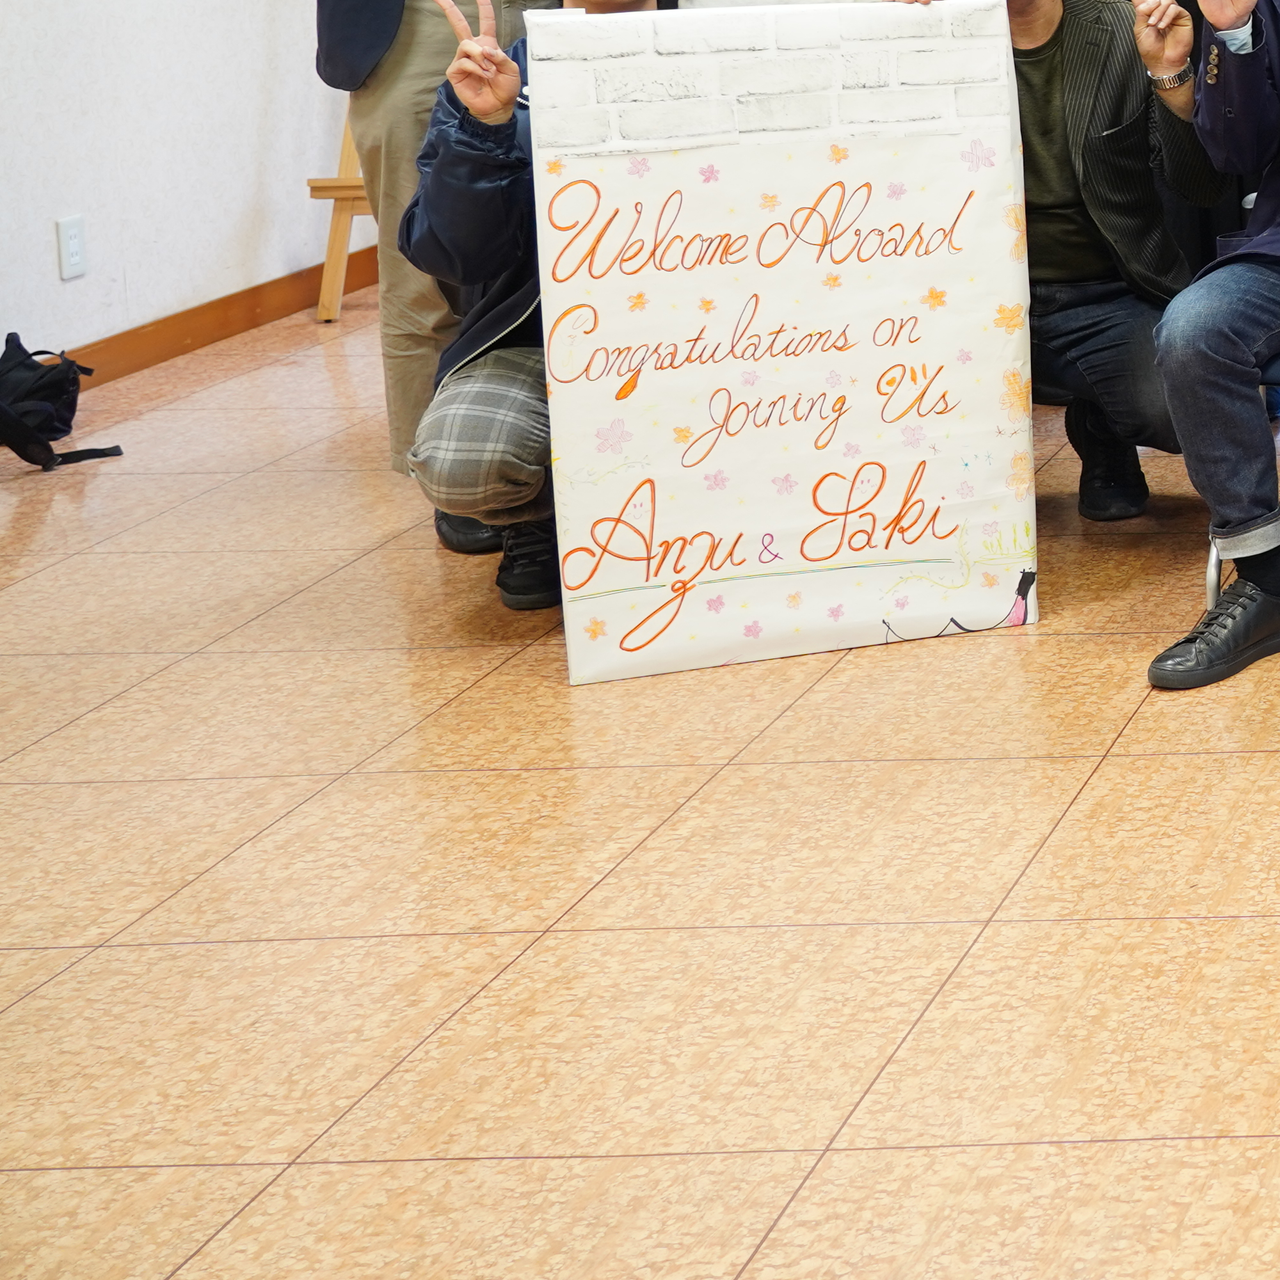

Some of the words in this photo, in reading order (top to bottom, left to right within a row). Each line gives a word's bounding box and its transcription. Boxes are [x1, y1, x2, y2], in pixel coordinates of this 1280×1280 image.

[548, 179, 749, 283] Welcome
[755, 180, 976, 268] Aboard
[873, 315, 922, 347] on
[681, 387, 852, 468] Joining
[876, 363, 962, 424] Us
[561, 478, 747, 652] Anzu
[758, 532, 784, 564] &
